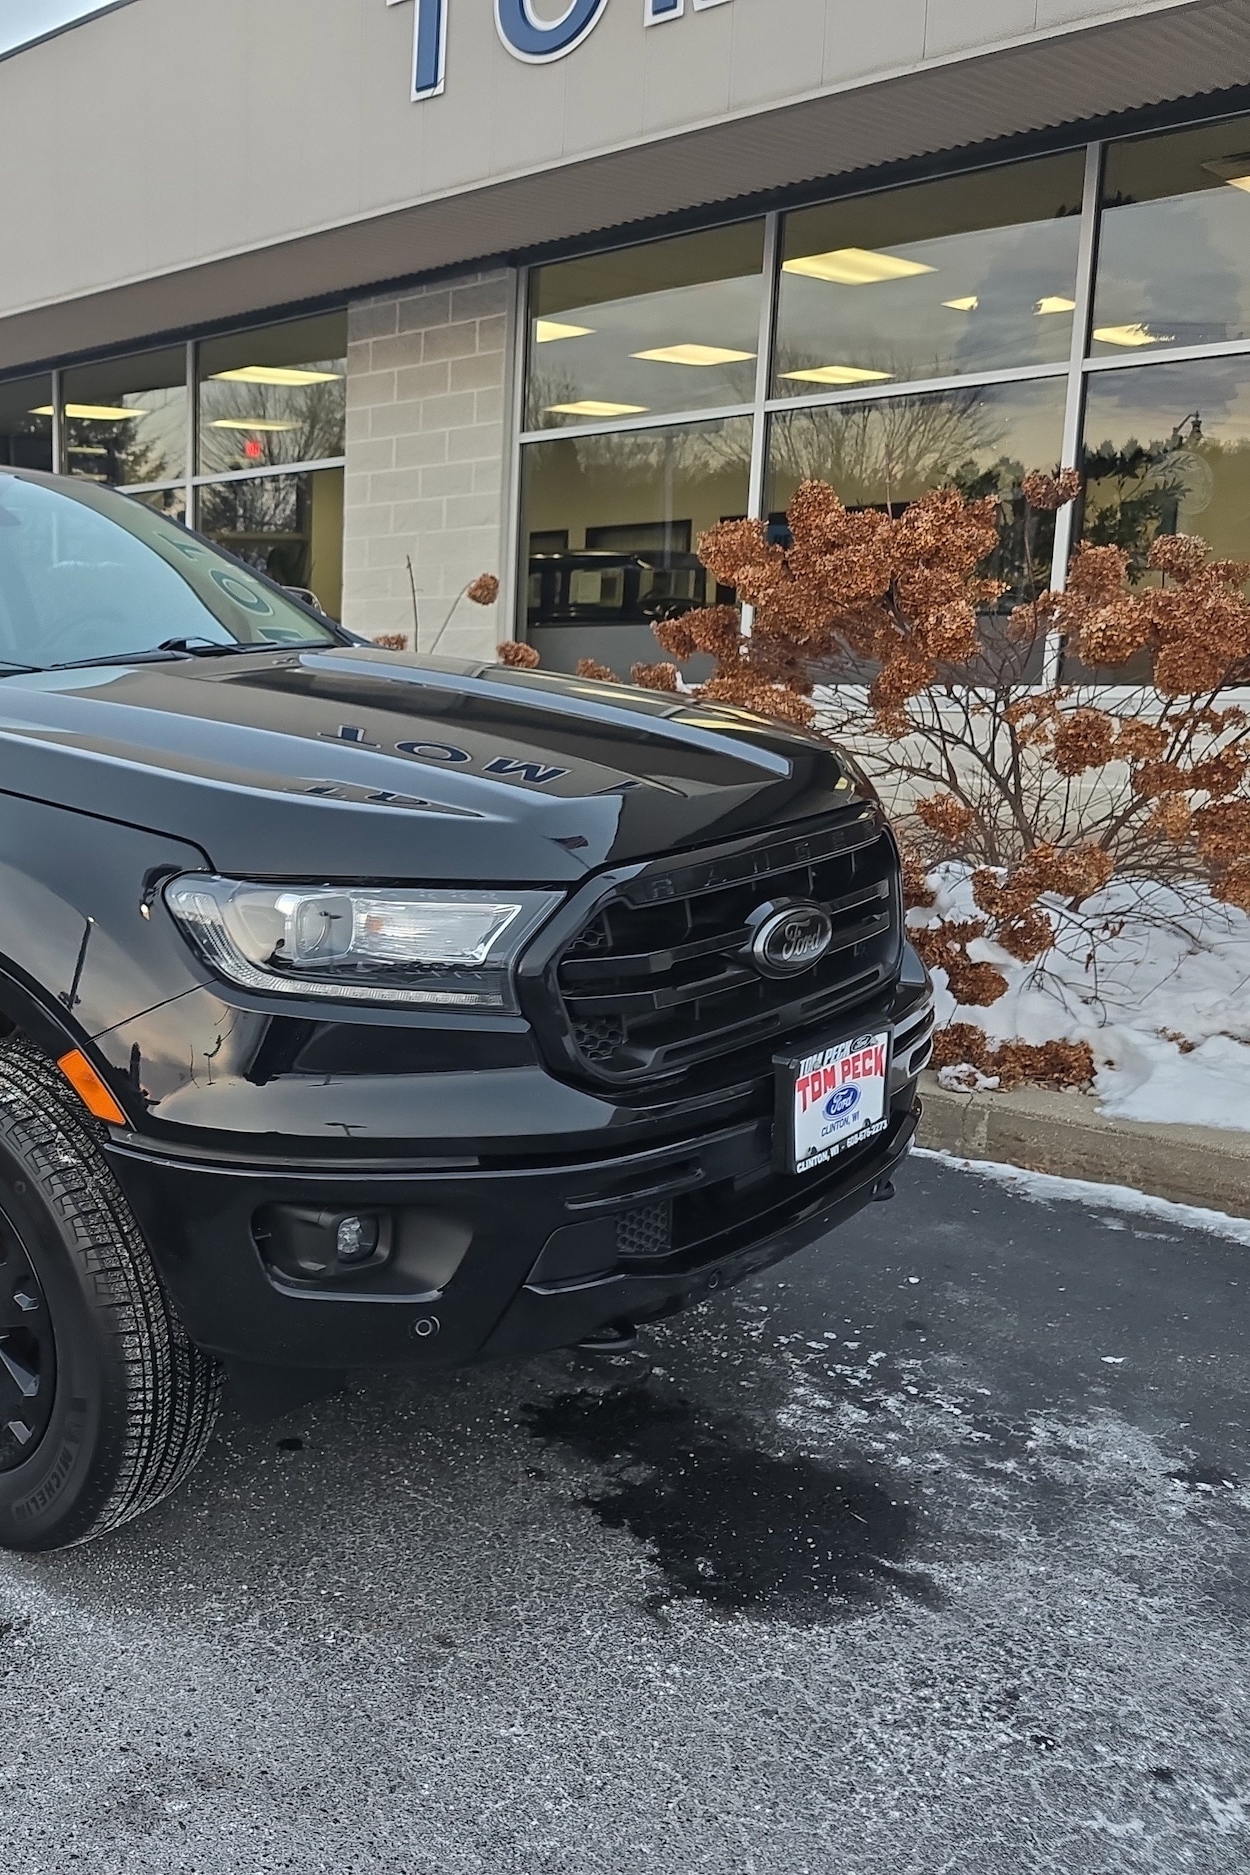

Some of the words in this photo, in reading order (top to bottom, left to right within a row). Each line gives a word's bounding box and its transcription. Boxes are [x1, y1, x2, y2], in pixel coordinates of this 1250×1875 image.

[386, 0, 736, 102] TO
[781, 917, 823, 962] Ford
[796, 1065, 837, 1114] TOM
[841, 1043, 886, 1084] PECK
[800, 1051, 824, 1077] TOM
[823, 1038, 854, 1066] PECK
[830, 1089, 855, 1115] Ford
[851, 1110, 861, 1124] WI
[796, 1150, 830, 1175] CLINTON,
[14, 1446, 74, 1520] MICHELIN
